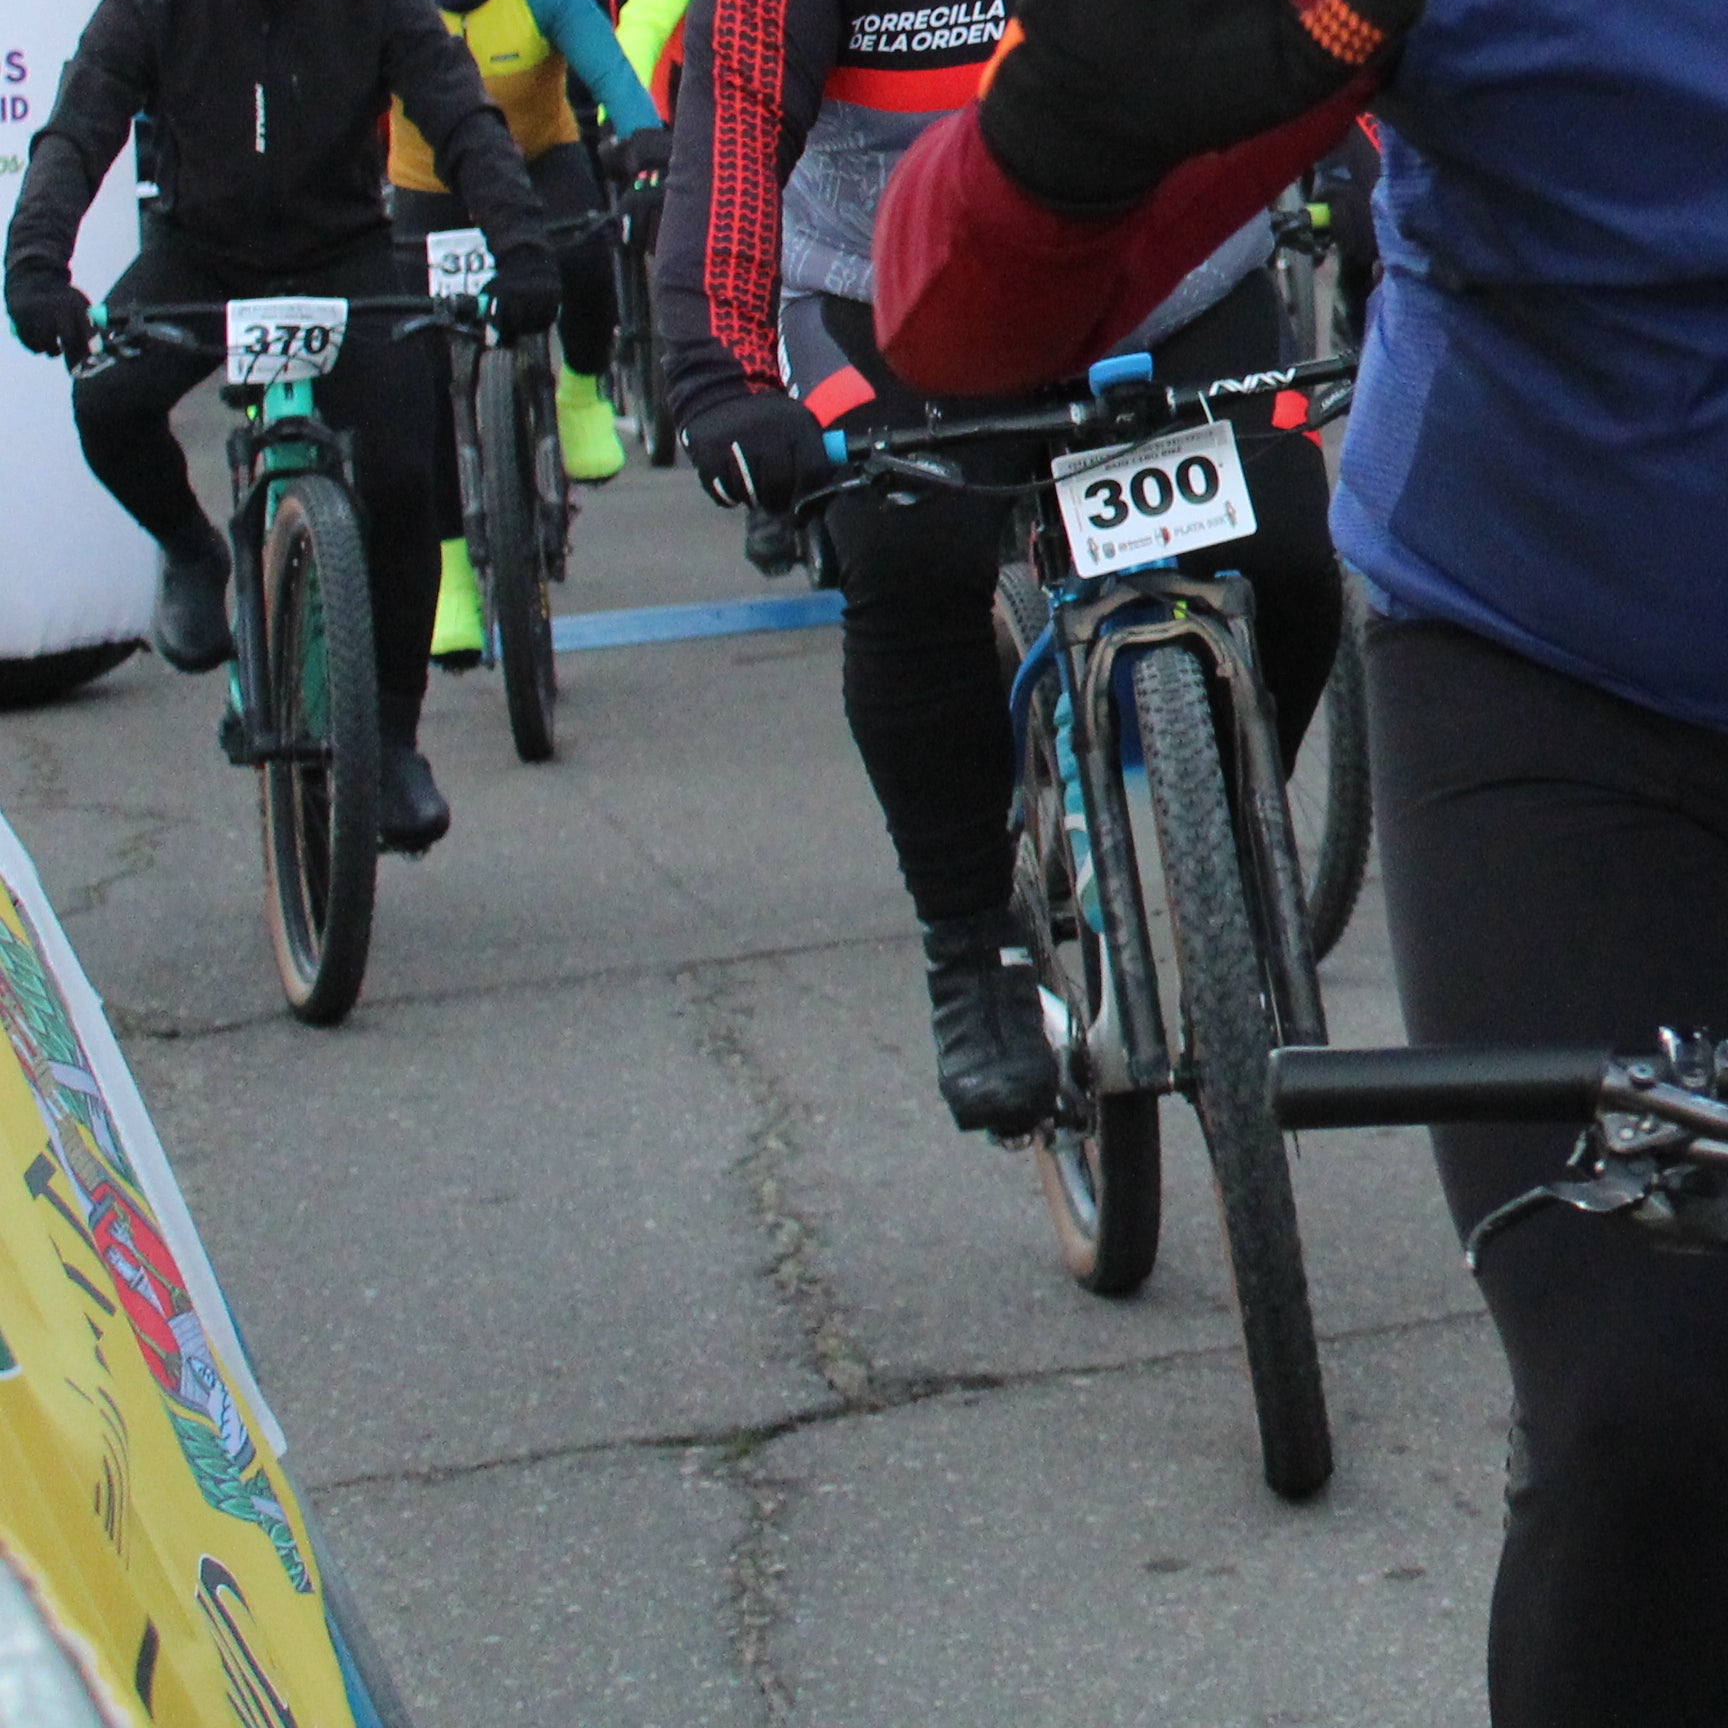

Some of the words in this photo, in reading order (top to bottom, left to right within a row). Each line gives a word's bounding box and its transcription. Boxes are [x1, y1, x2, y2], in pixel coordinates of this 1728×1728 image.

[848, 33, 878, 53] DE
[878, 28, 908, 53] LA
[911, 19, 1006, 52] ORDEN
[243, 324, 330, 356] 370
[1083, 454, 1220, 531] 300
